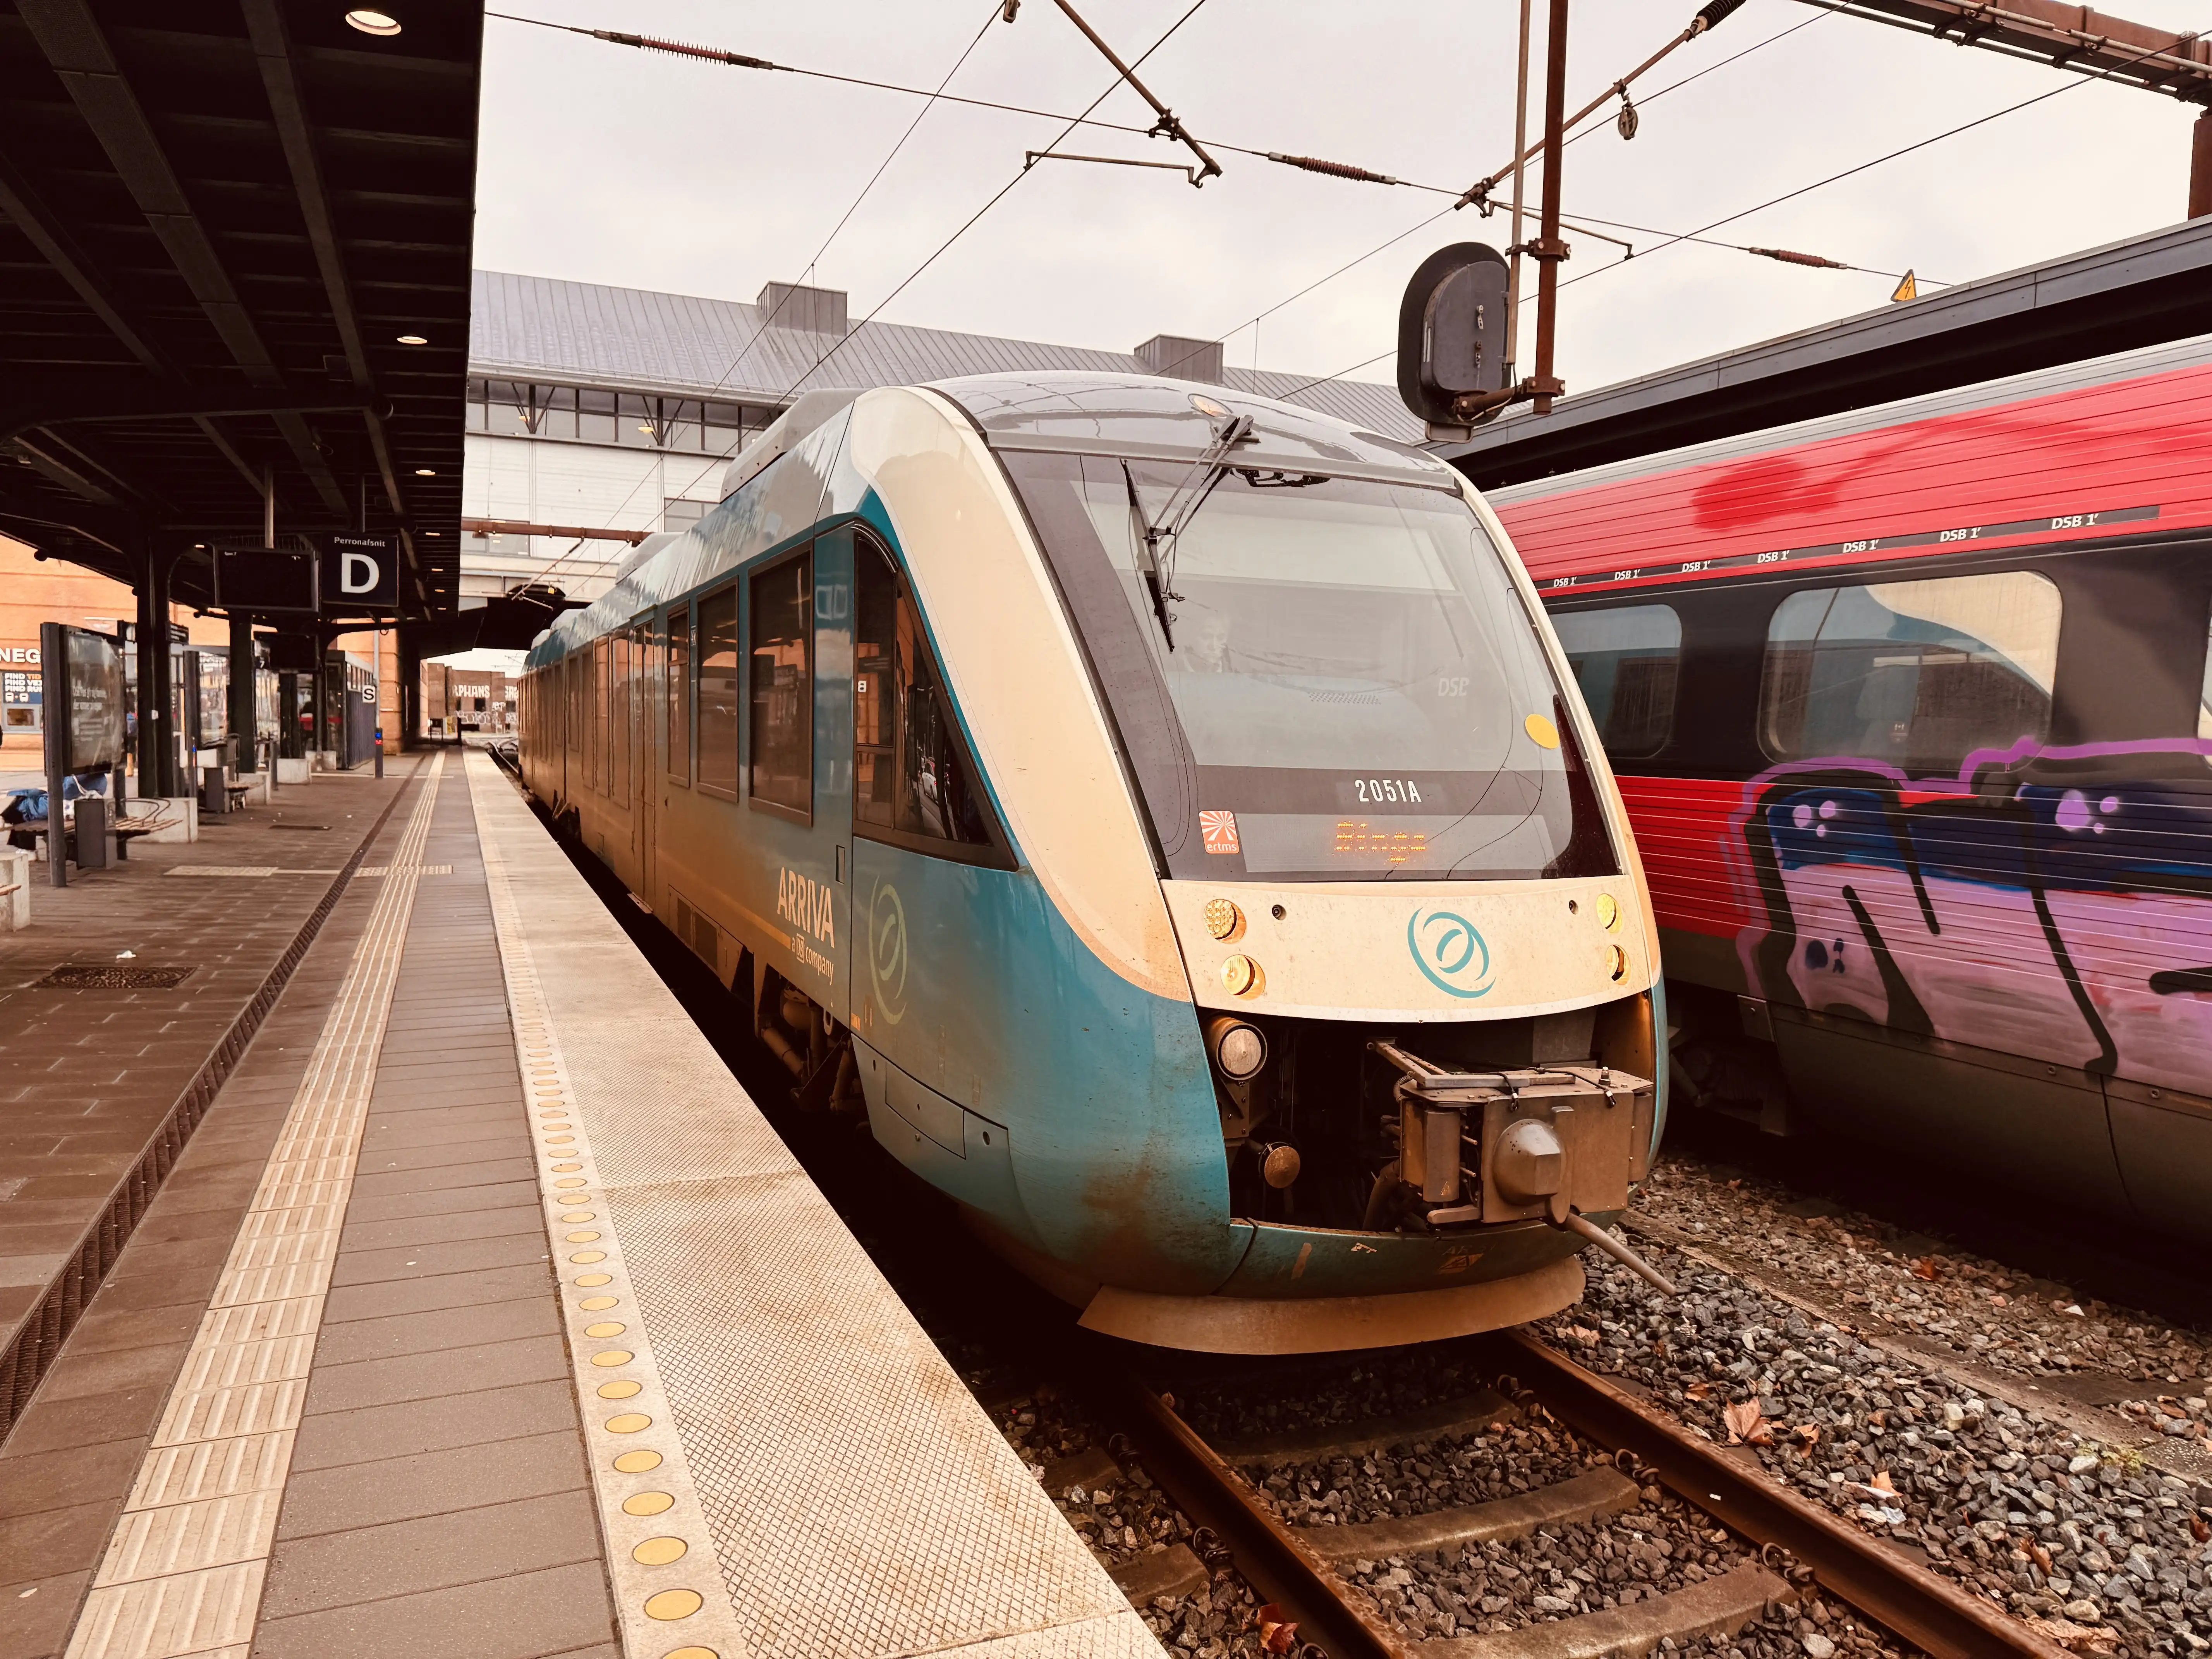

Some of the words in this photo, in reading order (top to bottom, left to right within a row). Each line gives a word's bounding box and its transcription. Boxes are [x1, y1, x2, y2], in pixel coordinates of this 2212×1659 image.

[2052, 515, 2082, 530] DSB
[334, 536, 386, 547] Perronafsnit
[1940, 529, 1966, 542] DSB
[1843, 541, 1867, 553] DSB
[1757, 551, 1778, 563] DSB
[341, 553, 379, 593] D
[1682, 562, 1700, 572] DSB
[1614, 570, 1631, 580] DSB
[1553, 577, 1568, 587] DSB
[364, 689, 374, 700] S
[1355, 779, 1422, 802] 2051A
[1207, 842, 1237, 852] ertms
[777, 867, 835, 948] ARRIVA
[792, 937, 795, 953] a
[805, 946, 834, 986] company
